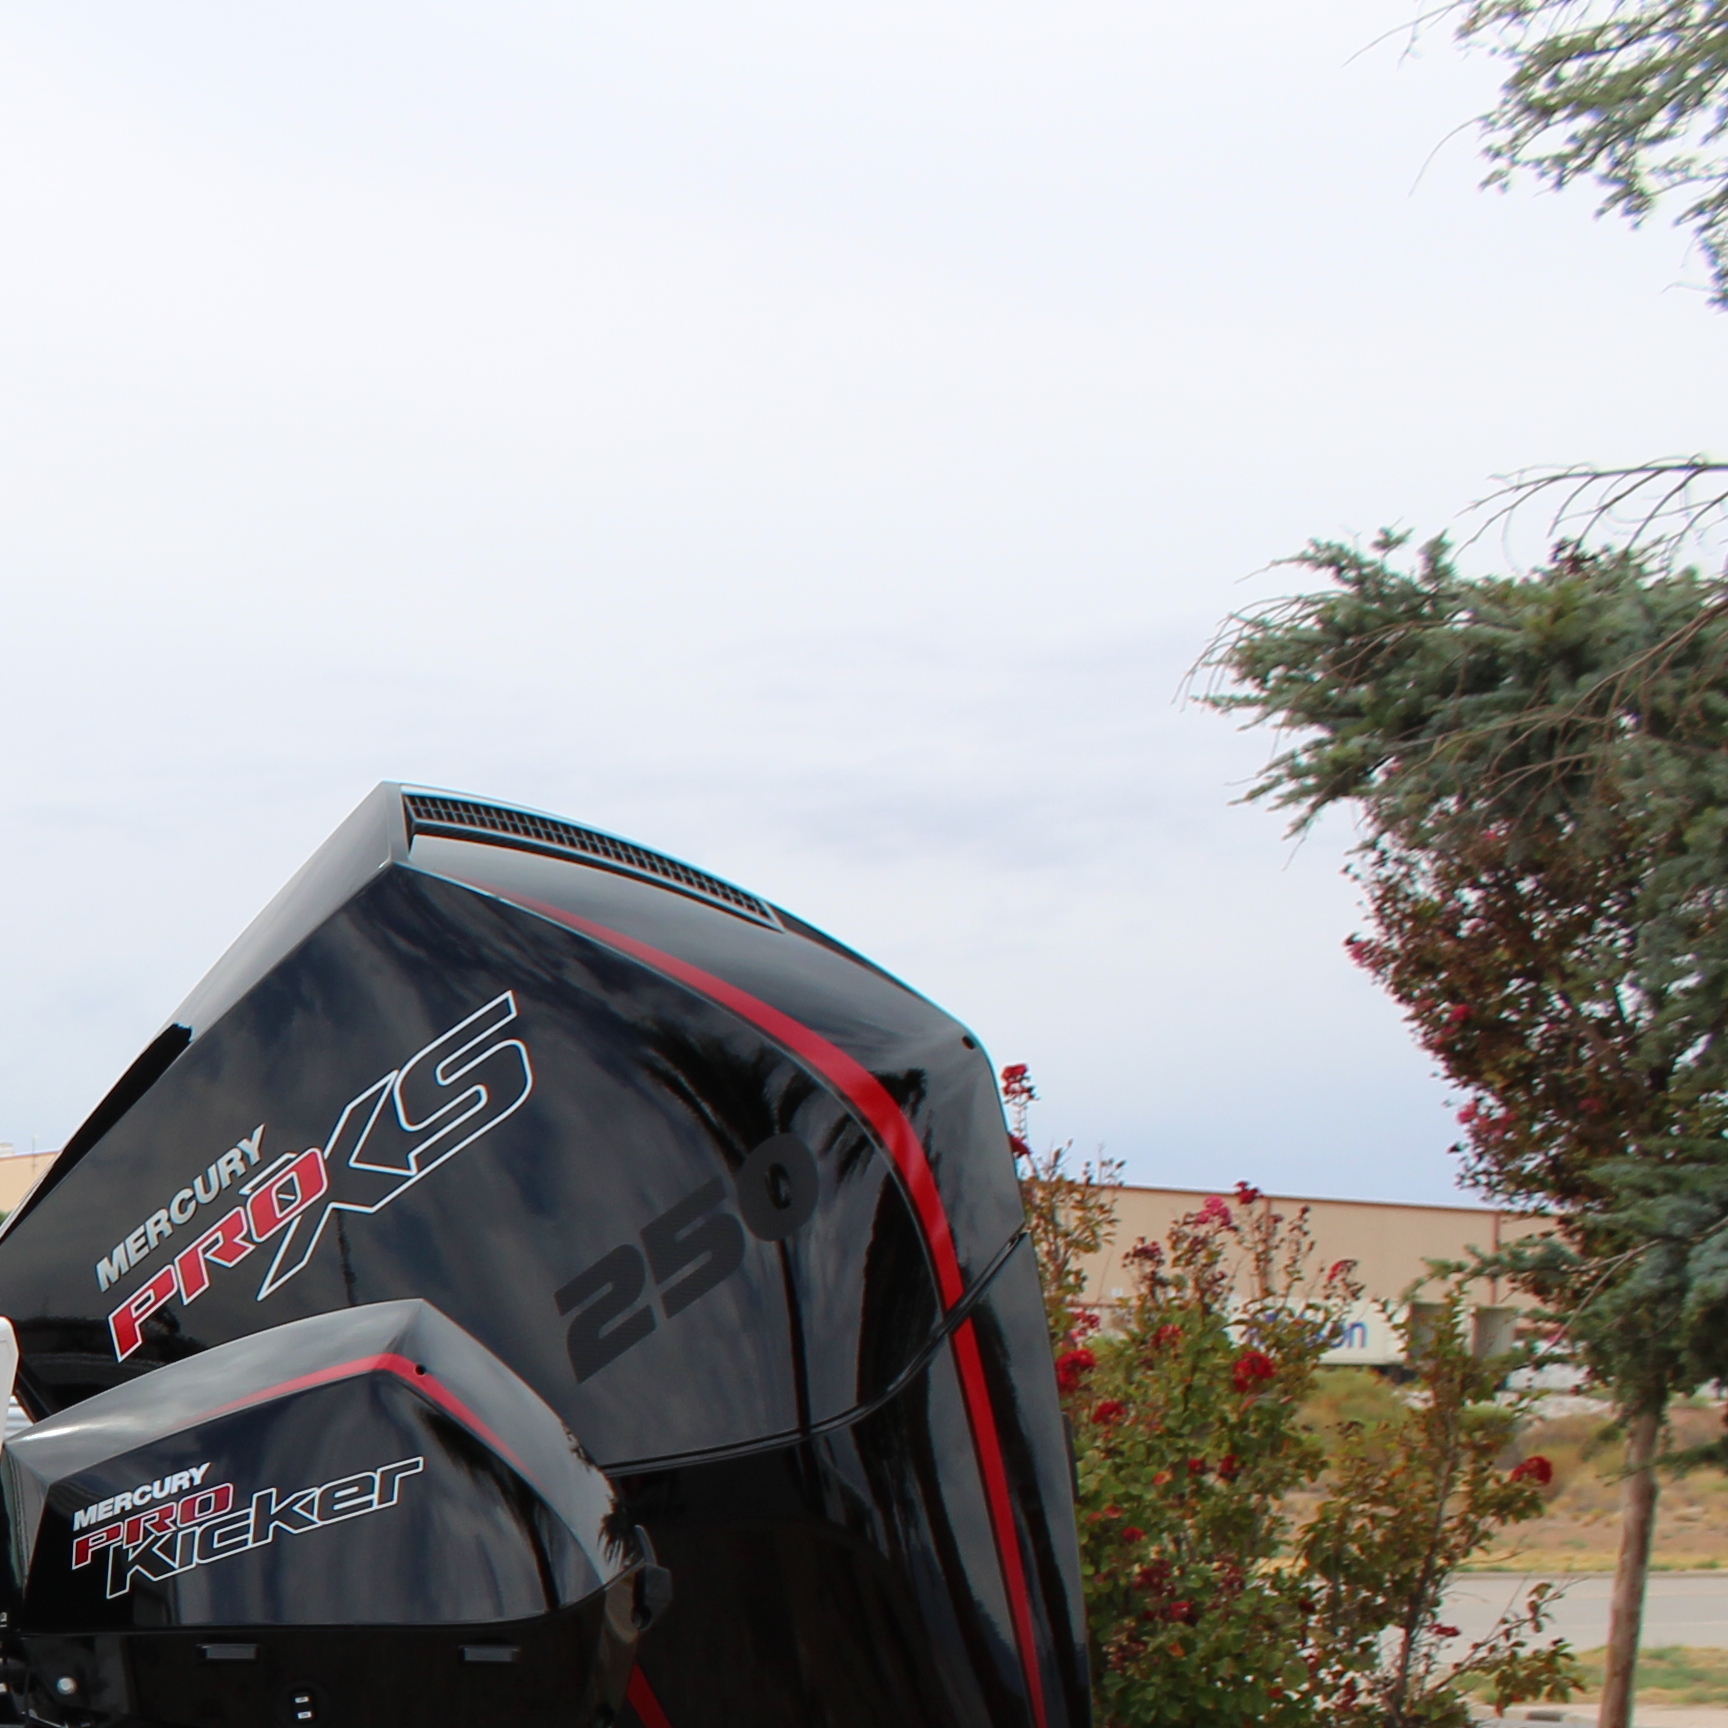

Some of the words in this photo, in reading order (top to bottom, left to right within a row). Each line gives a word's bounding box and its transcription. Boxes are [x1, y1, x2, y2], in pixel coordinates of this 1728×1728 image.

[93, 1123, 266, 1294] MERCURY
[107, 1147, 329, 1364] PRO
[239, 989, 535, 1302] XS
[553, 1131, 820, 1385] 250
[71, 1482, 235, 1571] PRO
[72, 1461, 213, 1532] MERCURY
